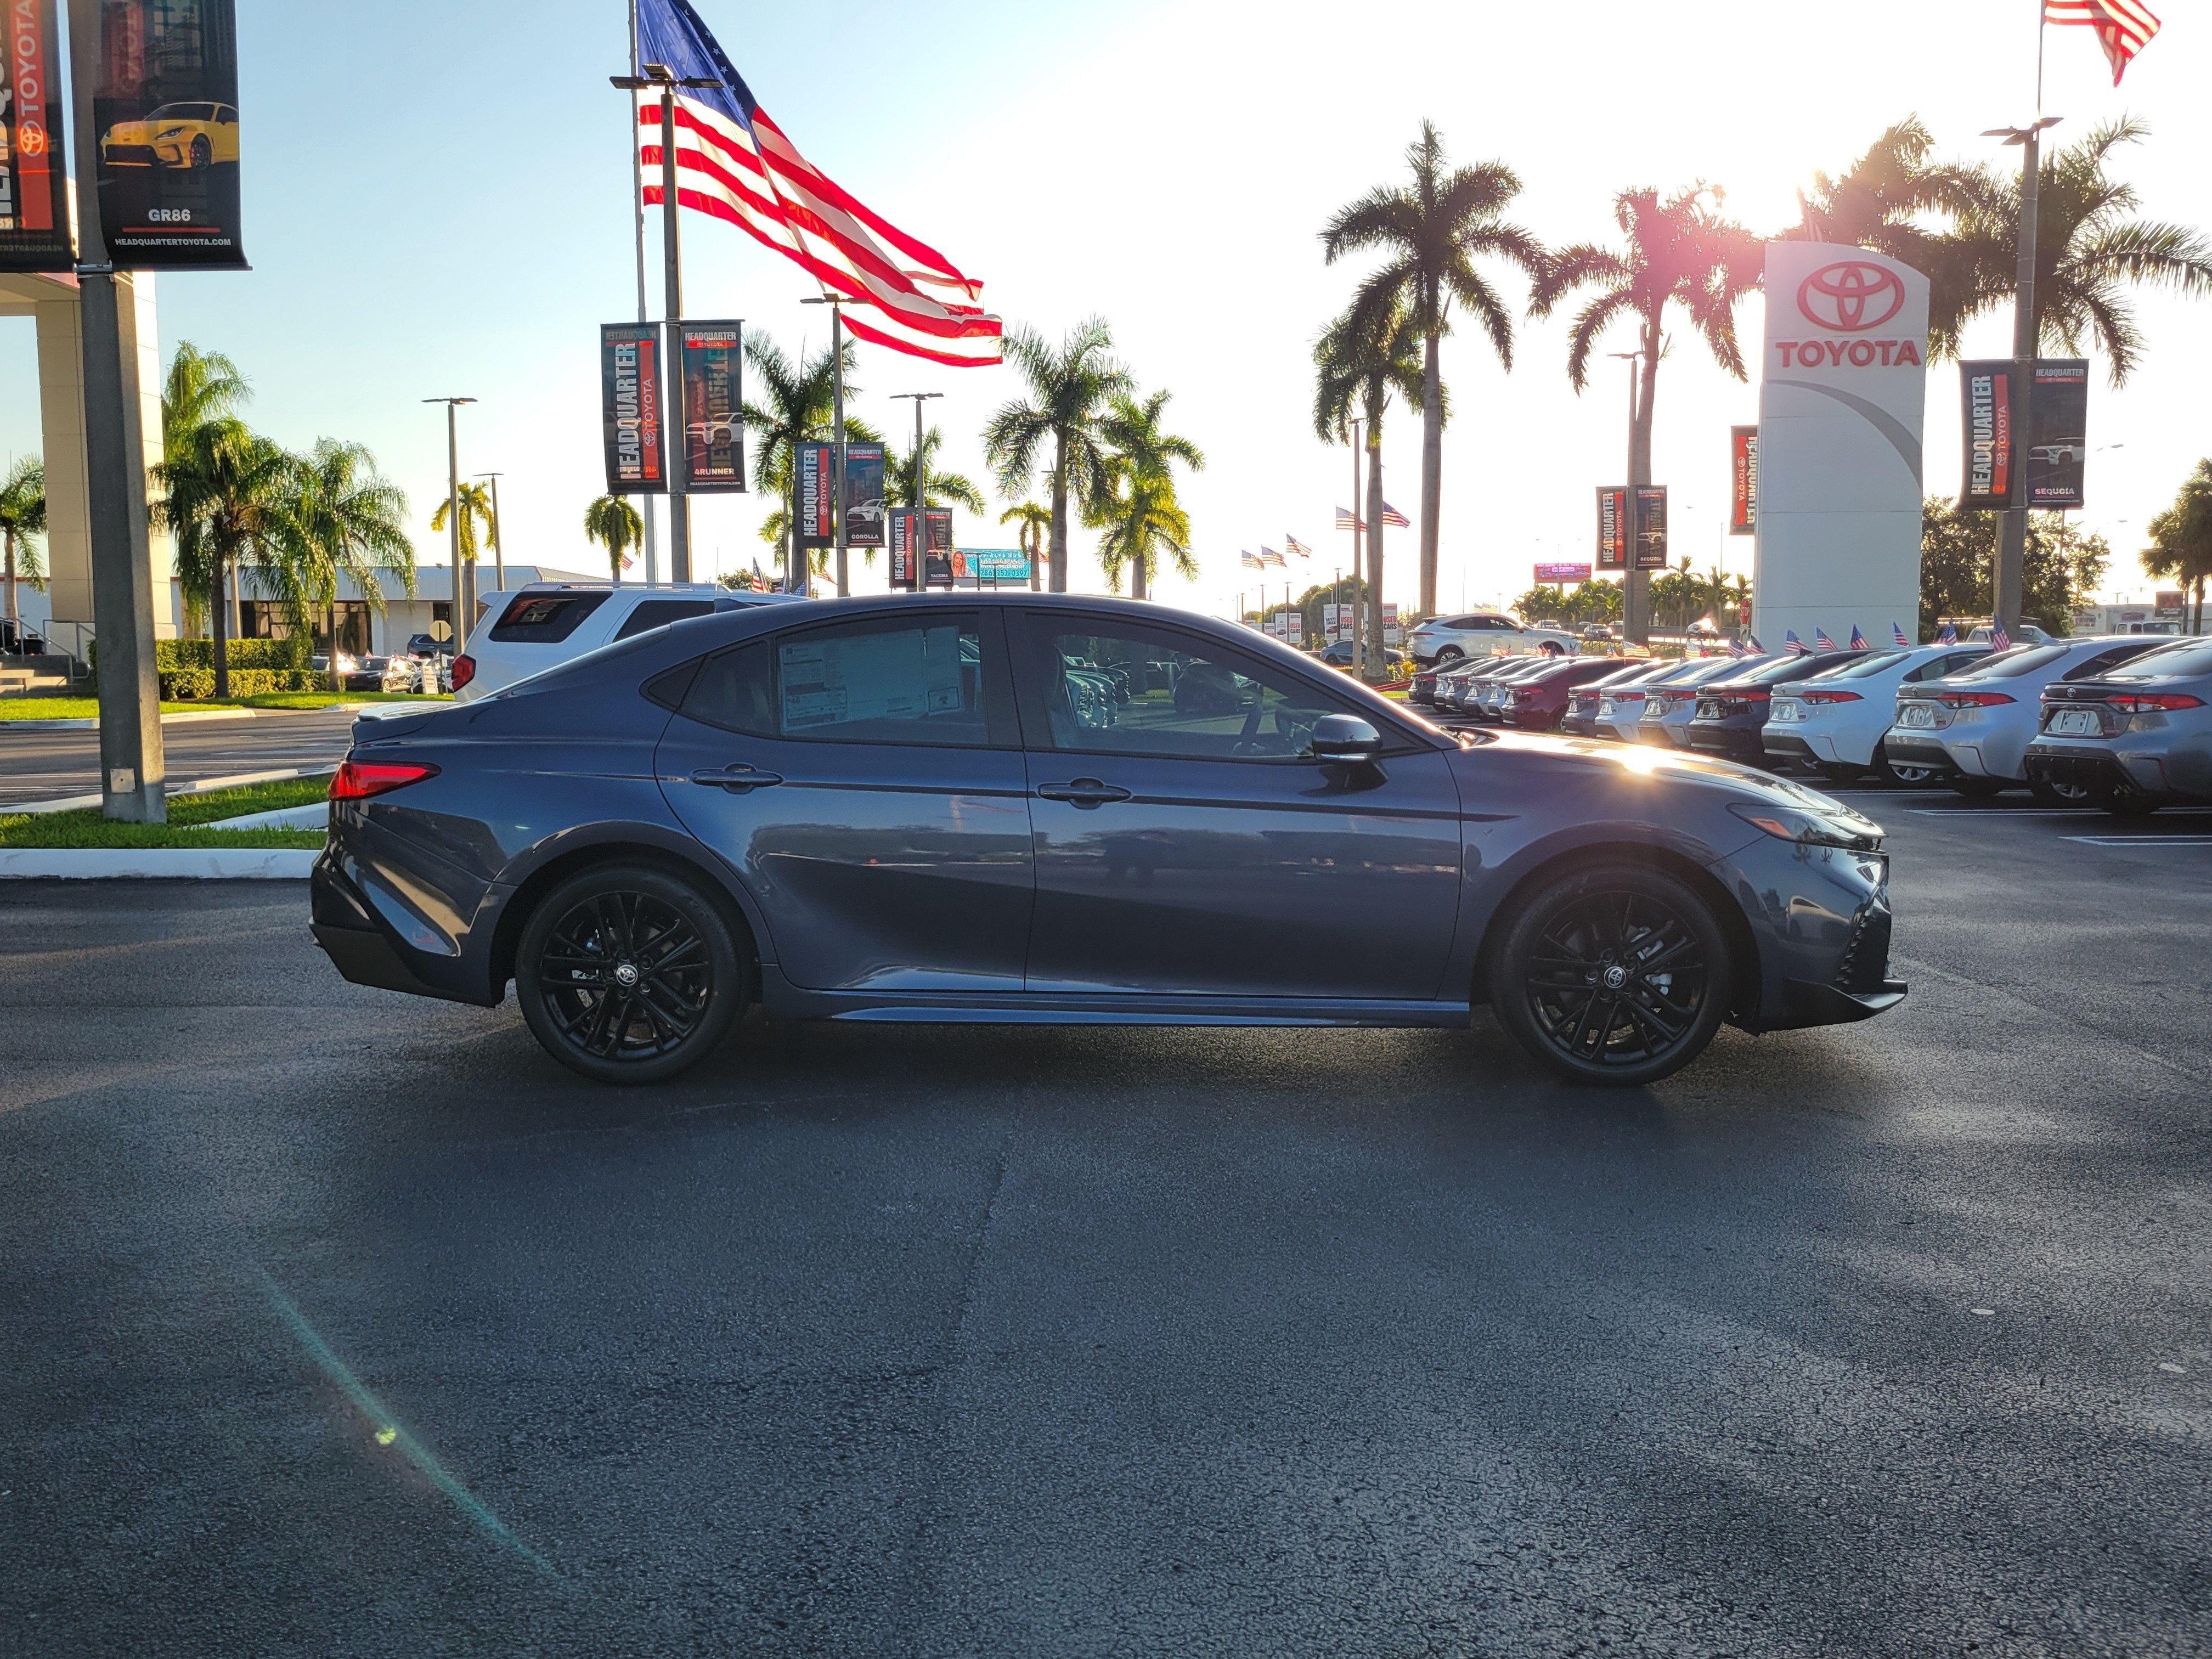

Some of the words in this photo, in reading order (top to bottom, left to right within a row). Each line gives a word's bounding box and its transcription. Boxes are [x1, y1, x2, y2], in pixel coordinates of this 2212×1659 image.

[15, 0, 39, 117] TOYOTA
[149, 209, 191, 221] GR86
[115, 238, 232, 246] HEADQUARTERTOYOTA.COM
[685, 332, 736, 341] HEADQUARTER
[1775, 340, 1921, 367] TOYOTA
[2035, 369, 2084, 377] HEADQUARTER
[615, 343, 641, 479] HEADQUARTER
[644, 379, 653, 429] TOYOTA
[1998, 405, 2007, 450] TOYOTA
[1971, 376, 1995, 494] HEADQUARTER
[804, 449, 819, 536] HEADQUARTER
[895, 517, 906, 580] HEADQUARTER
[1602, 493, 1616, 562] HEADQUARTER
